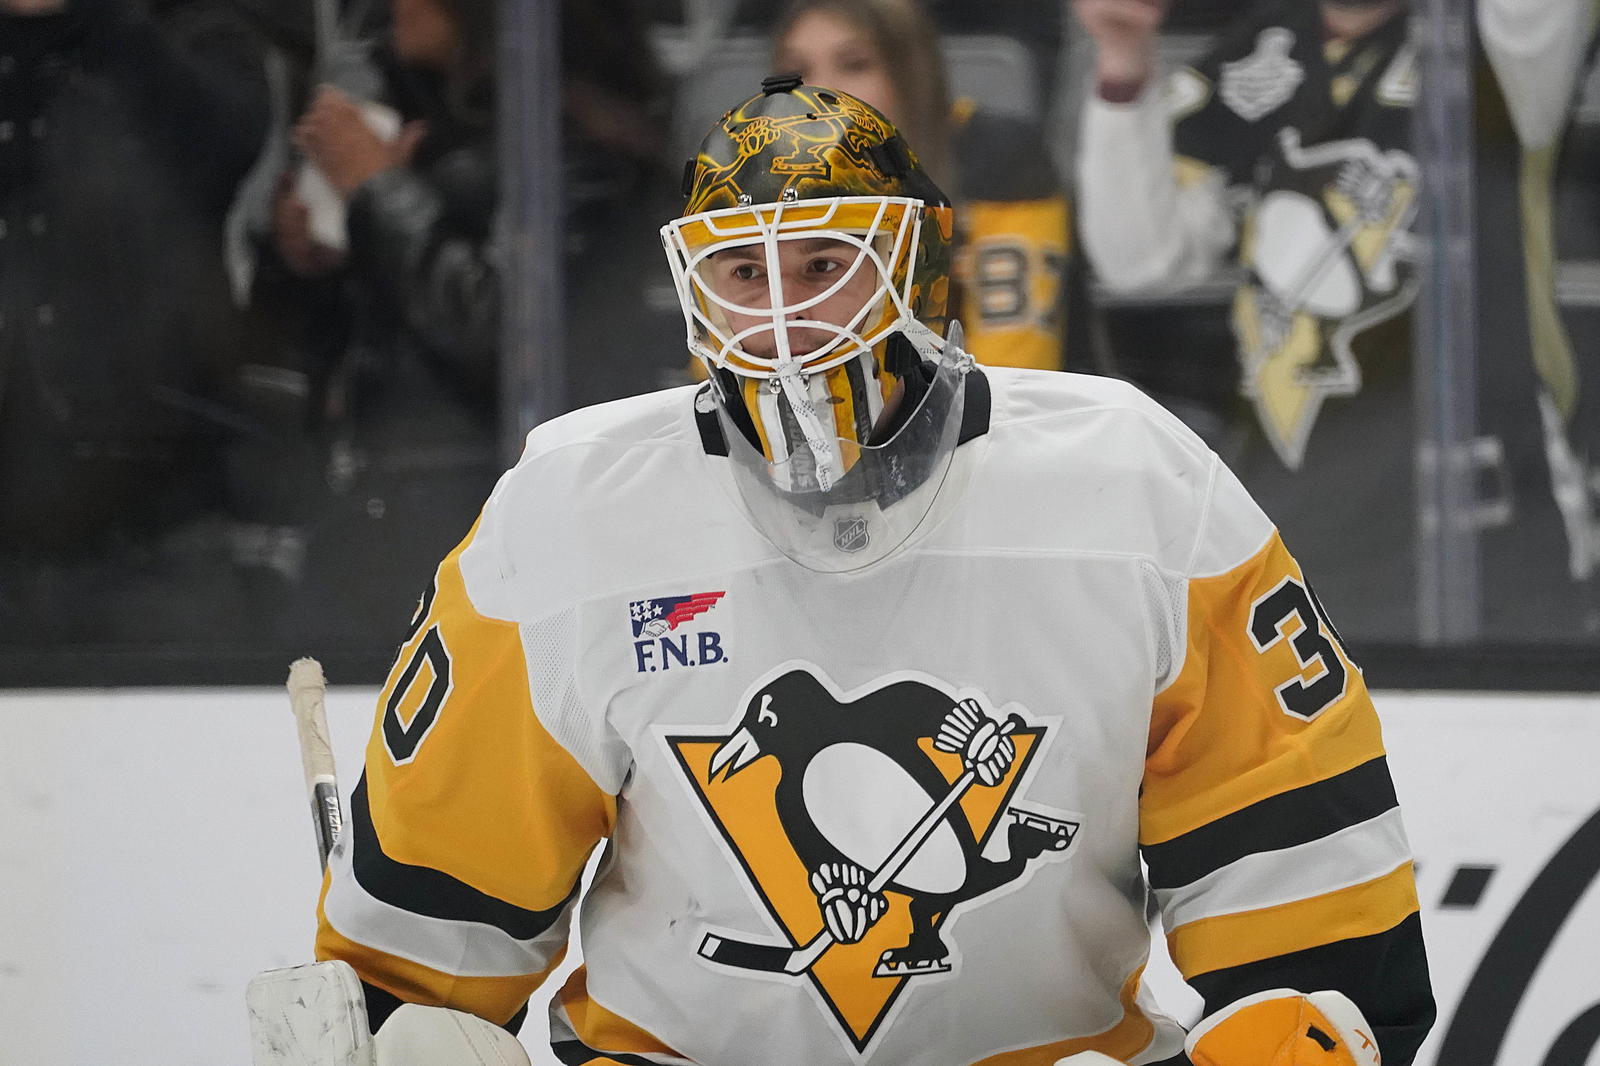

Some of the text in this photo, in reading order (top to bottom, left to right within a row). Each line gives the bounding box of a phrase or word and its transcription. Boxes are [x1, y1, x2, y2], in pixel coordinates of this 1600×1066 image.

[841, 524, 864, 547] NHL
[388, 570, 454, 767] 0
[634, 632, 729, 673] F.N.B.
[1246, 575, 1358, 723] 3
